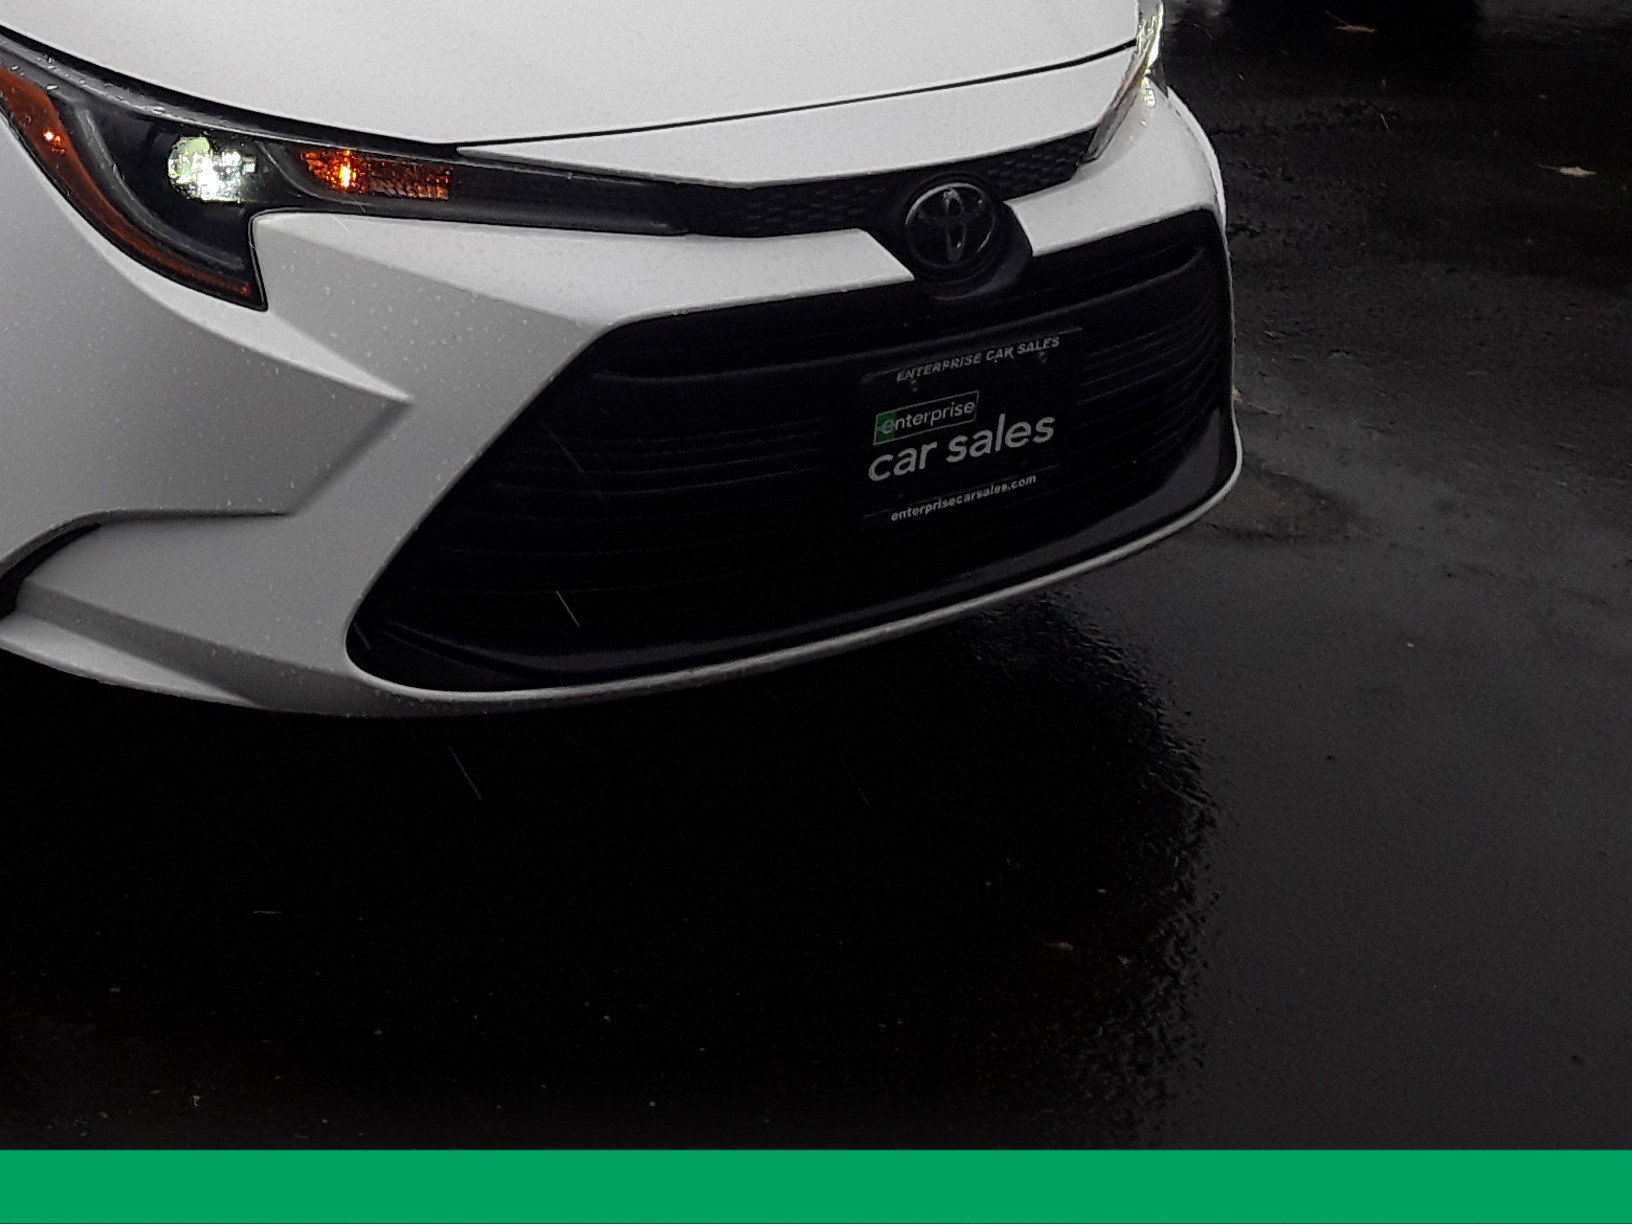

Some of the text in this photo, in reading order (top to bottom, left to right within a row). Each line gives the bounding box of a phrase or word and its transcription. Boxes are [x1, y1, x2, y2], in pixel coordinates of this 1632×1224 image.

[896, 336, 1060, 382] ENTERPRISE CAR SALES
[880, 400, 975, 435] enterprise
[868, 413, 1056, 482] car sales
[891, 474, 1037, 522] enterprisecarsales.com
